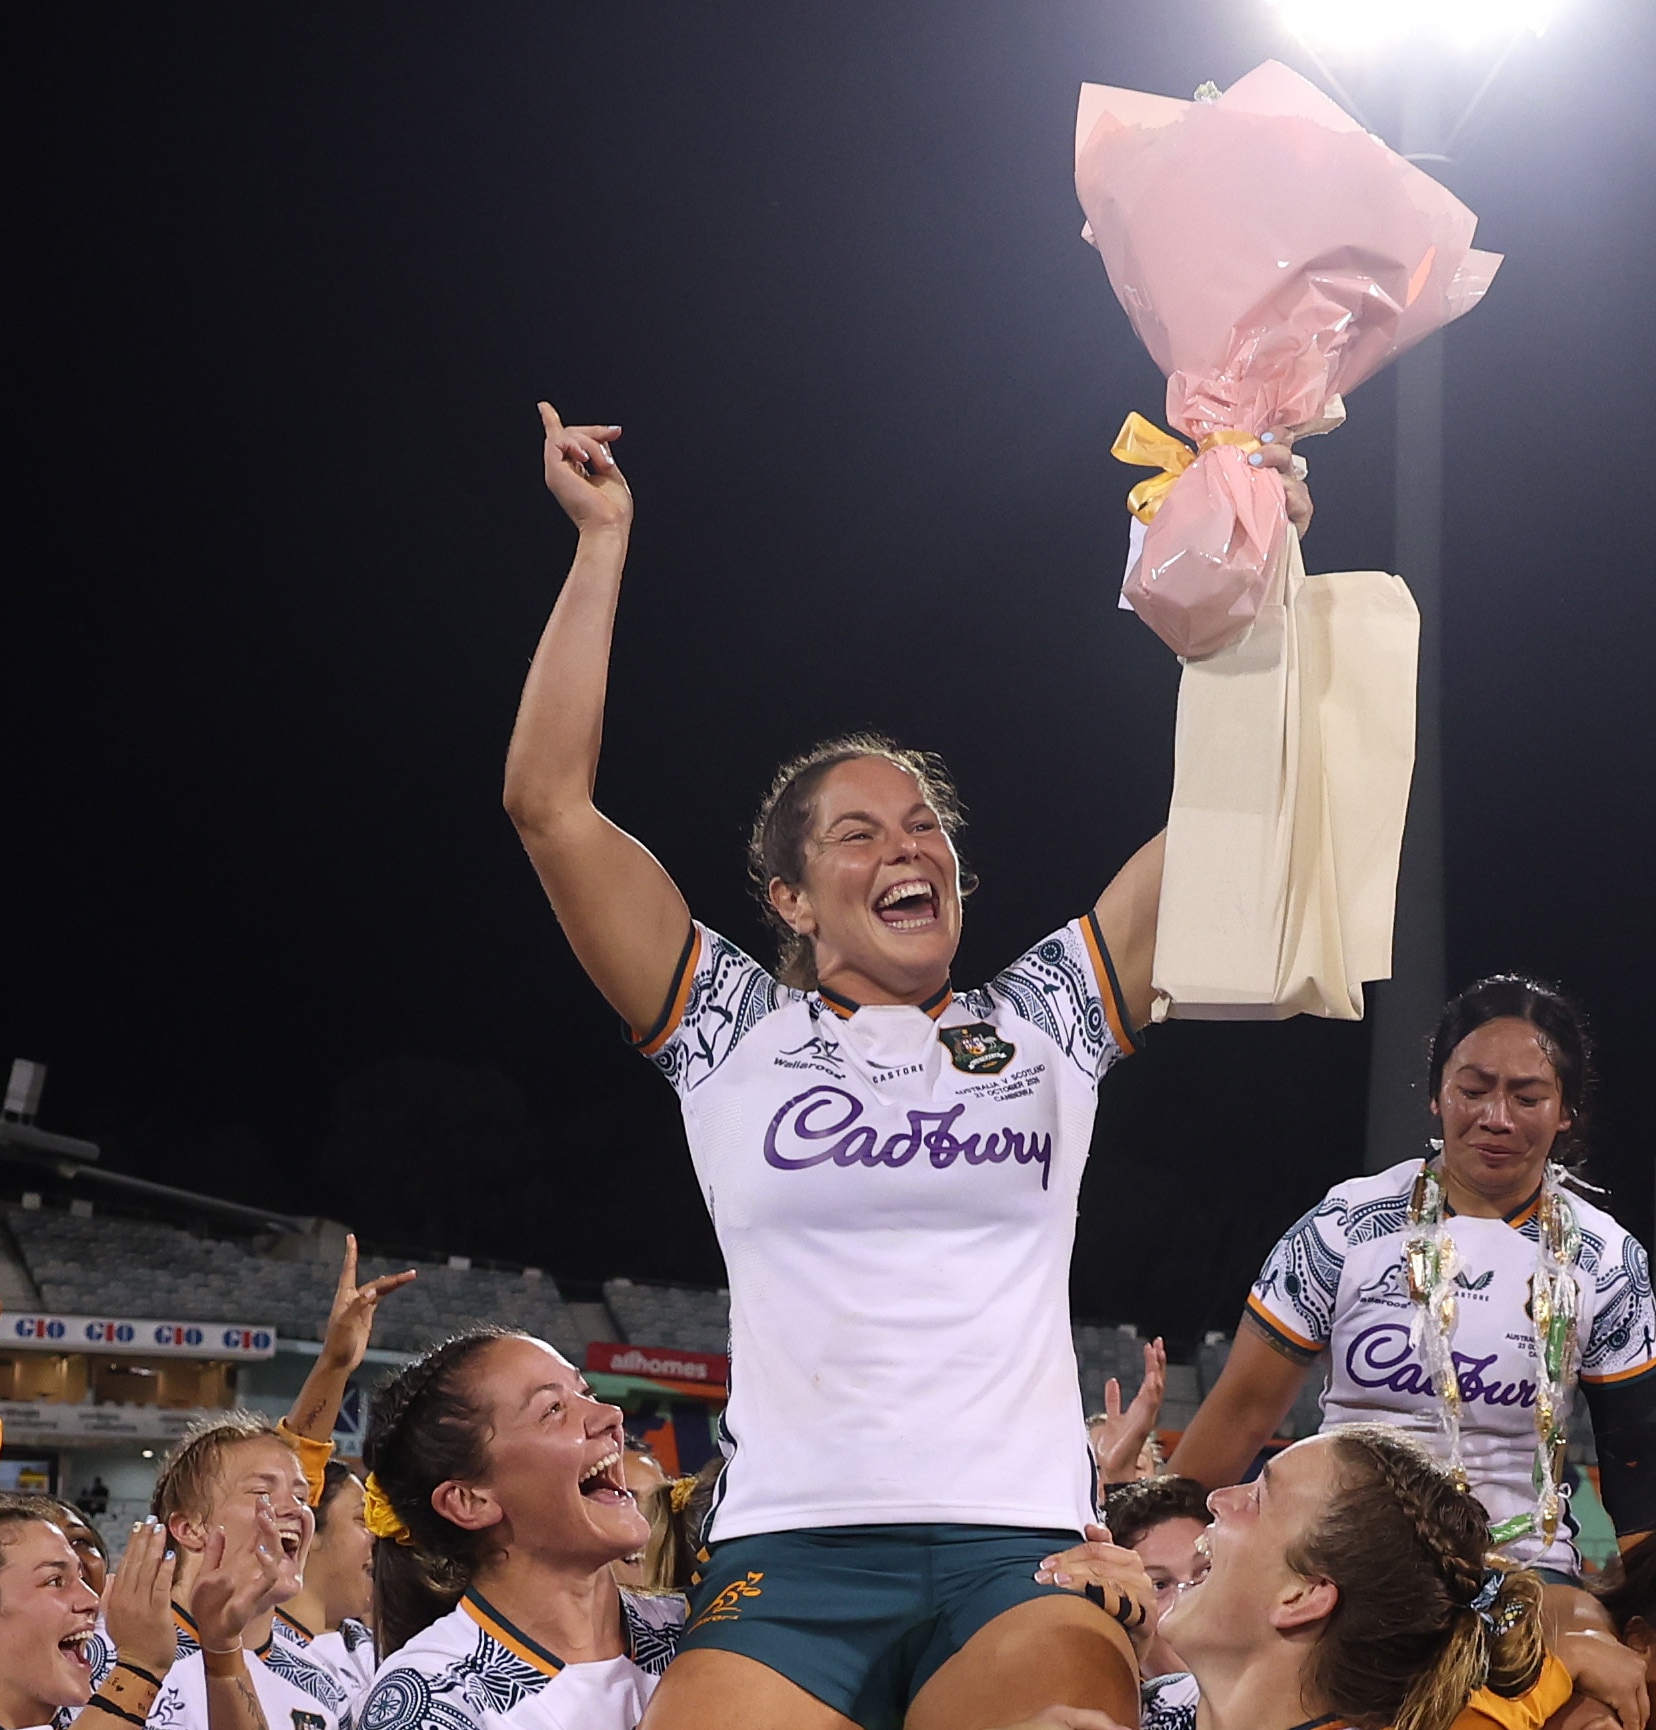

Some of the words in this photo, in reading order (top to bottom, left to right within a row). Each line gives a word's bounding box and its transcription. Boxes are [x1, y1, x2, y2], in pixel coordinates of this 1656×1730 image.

[872, 1063, 925, 1084] CASTORE
[1010, 1064, 1047, 1081] SCOTLAND
[988, 1083, 1025, 1096] OCTOBER
[763, 1085, 1052, 1191] Cadbury
[1454, 1290, 1490, 1302] ASTORE
[15, 1318, 66, 1339] GIO
[86, 1322, 136, 1343] GIO
[155, 1325, 204, 1346] GIO
[222, 1329, 272, 1350] GIO
[610, 1350, 707, 1379] allhomes
